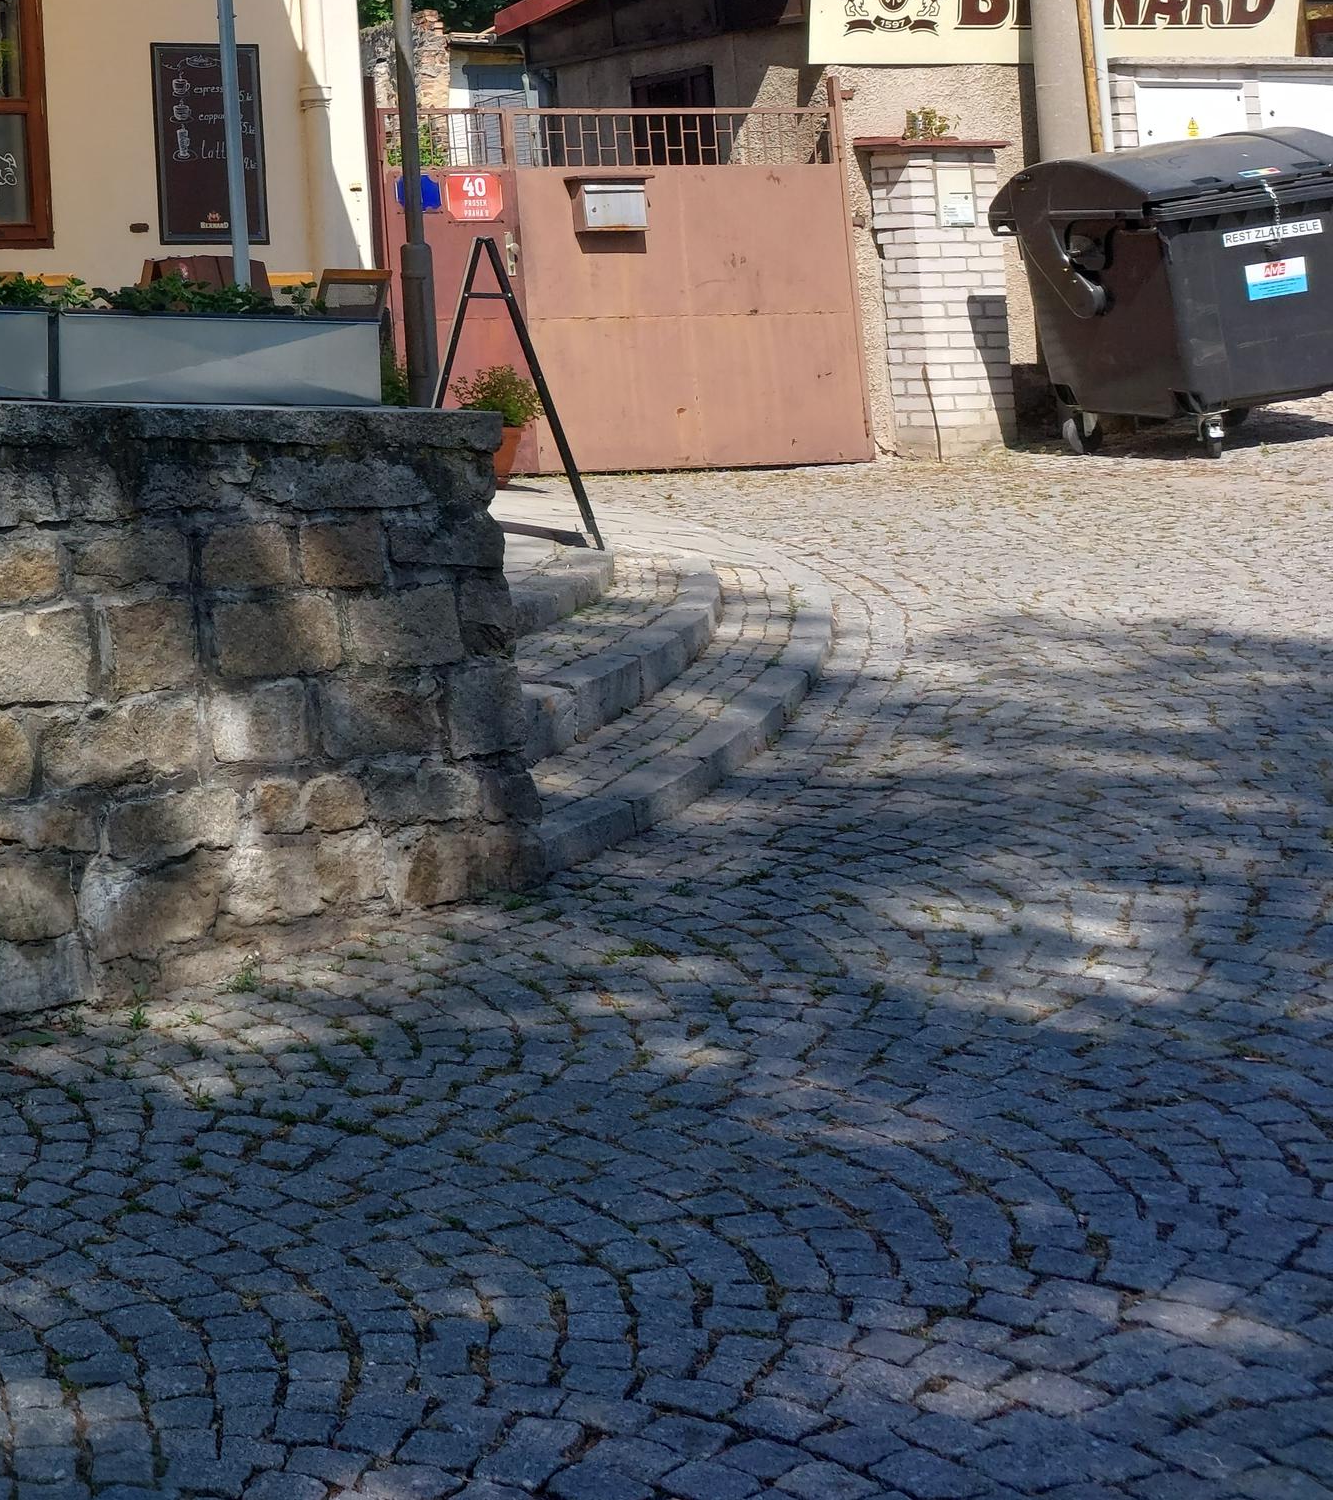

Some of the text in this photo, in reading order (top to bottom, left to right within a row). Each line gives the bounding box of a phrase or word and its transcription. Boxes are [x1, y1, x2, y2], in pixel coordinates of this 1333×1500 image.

[879, 18, 906, 29] 1597
[462, 176, 487, 197] 40
[1225, 230, 1252, 245] REST
[1291, 220, 1321, 234] SELE
[1264, 262, 1286, 278] AVE
